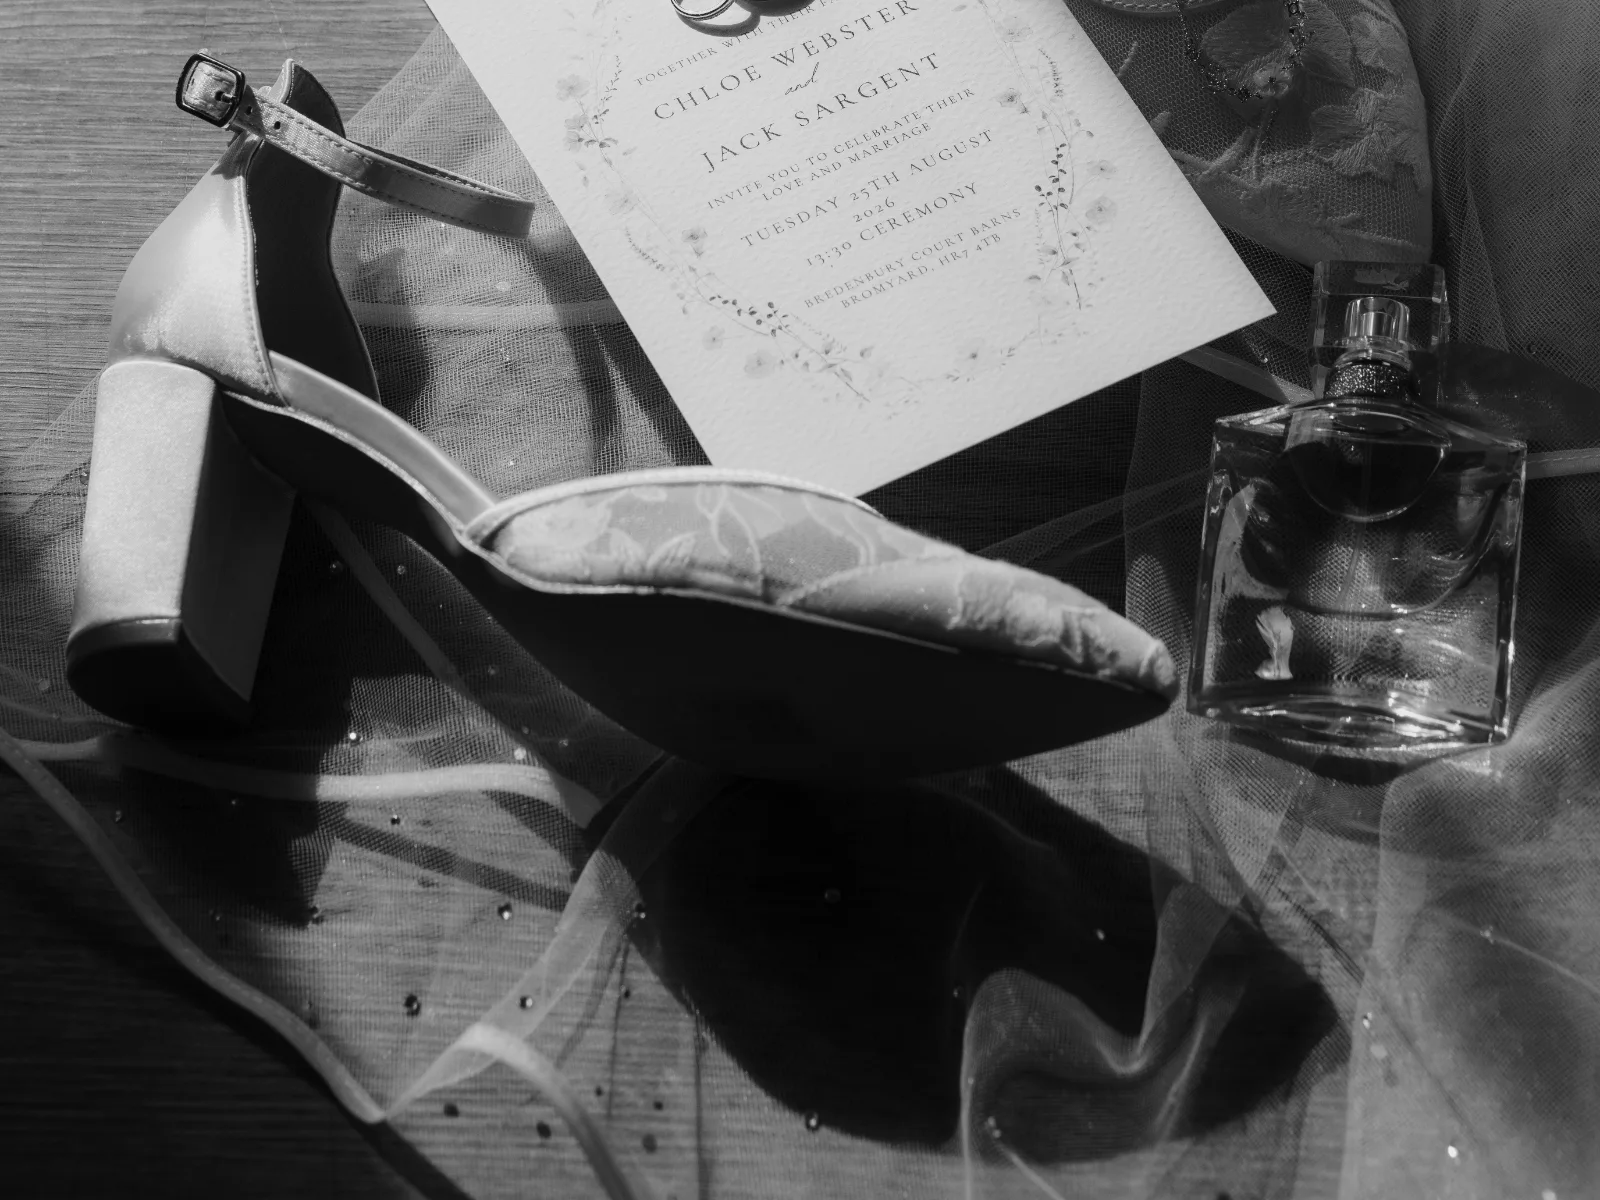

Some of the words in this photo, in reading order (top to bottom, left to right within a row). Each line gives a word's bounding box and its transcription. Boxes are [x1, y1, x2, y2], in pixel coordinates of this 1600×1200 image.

[636, 47, 719, 87] TOGETHER
[721, 26, 764, 49] WITH
[767, 5, 815, 29] THEIR
[653, 64, 763, 120] CHLOE
[770, 0, 920, 68] WEBSTER
[784, 61, 821, 97] and
[700, 122, 783, 175] JACK
[794, 52, 940, 128] SARGENT
[707, 180, 763, 210] INVITE
[767, 163, 801, 183] YOU
[805, 152, 828, 166] TO
[833, 110, 922, 155] CELEBRATE
[925, 88, 976, 114] THEIR
[740, 195, 839, 248] TUESDAY
[849, 170, 901, 202] 25TH
[910, 129, 993, 177] AUGUST
[761, 177, 804, 202] LOVE
[810, 161, 843, 182] AND
[847, 122, 932, 165] MARRIAGE
[806, 241, 853, 267] 13:30
[859, 181, 977, 242] CEREMONY
[852, 196, 896, 224] 2026
[803, 257, 905, 309] BREDENBURY
[911, 232, 964, 262] COURT
[969, 208, 1022, 237] BARNS
[840, 265, 935, 309] BROMYARD,
[938, 249, 969, 267] HR7
[975, 233, 1002, 252] 4TB
